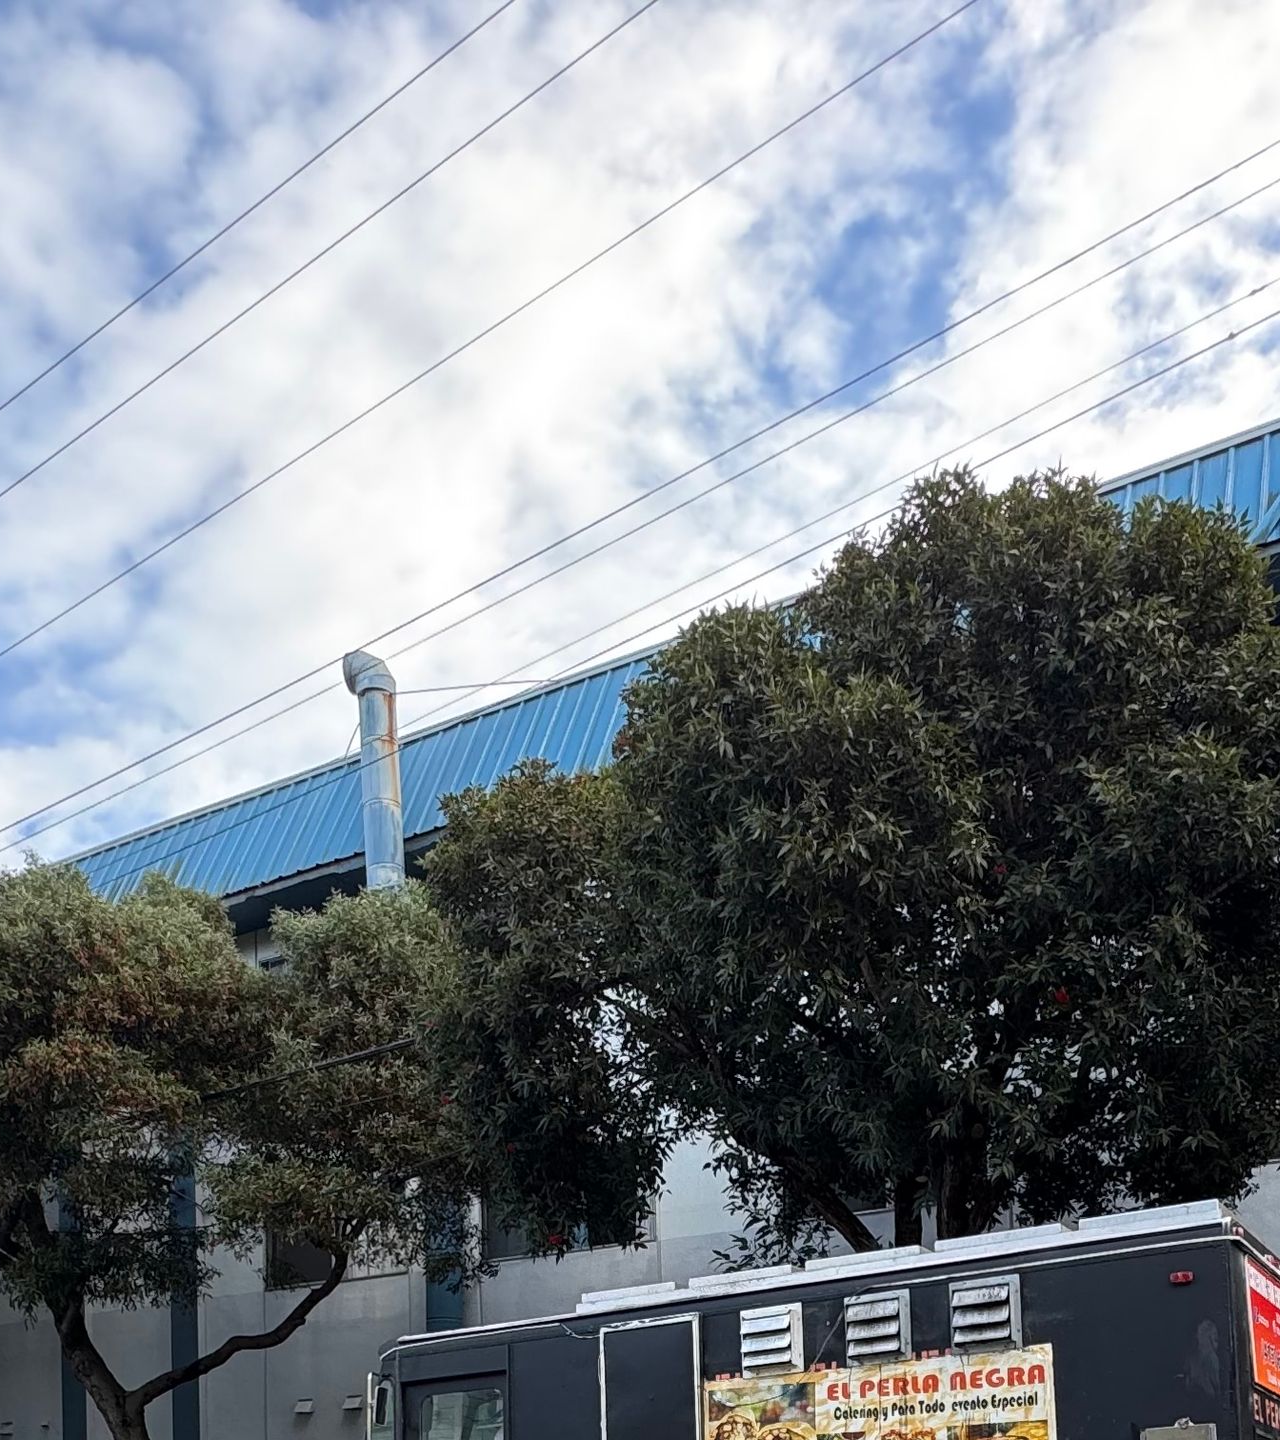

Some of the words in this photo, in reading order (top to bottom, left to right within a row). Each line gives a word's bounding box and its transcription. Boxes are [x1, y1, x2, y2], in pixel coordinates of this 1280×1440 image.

[827, 1383, 851, 1402] EL
[860, 1374, 939, 1399] PERLA
[950, 1364, 1045, 1392] NEGRA
[834, 1404, 879, 1422] Catering
[881, 1406, 888, 1421] y
[891, 1402, 915, 1416] Para
[918, 1399, 945, 1414] Todo
[951, 1395, 988, 1412] evento
[991, 1391, 1038, 1411] Especial
[1253, 1393, 1264, 1424] EL
